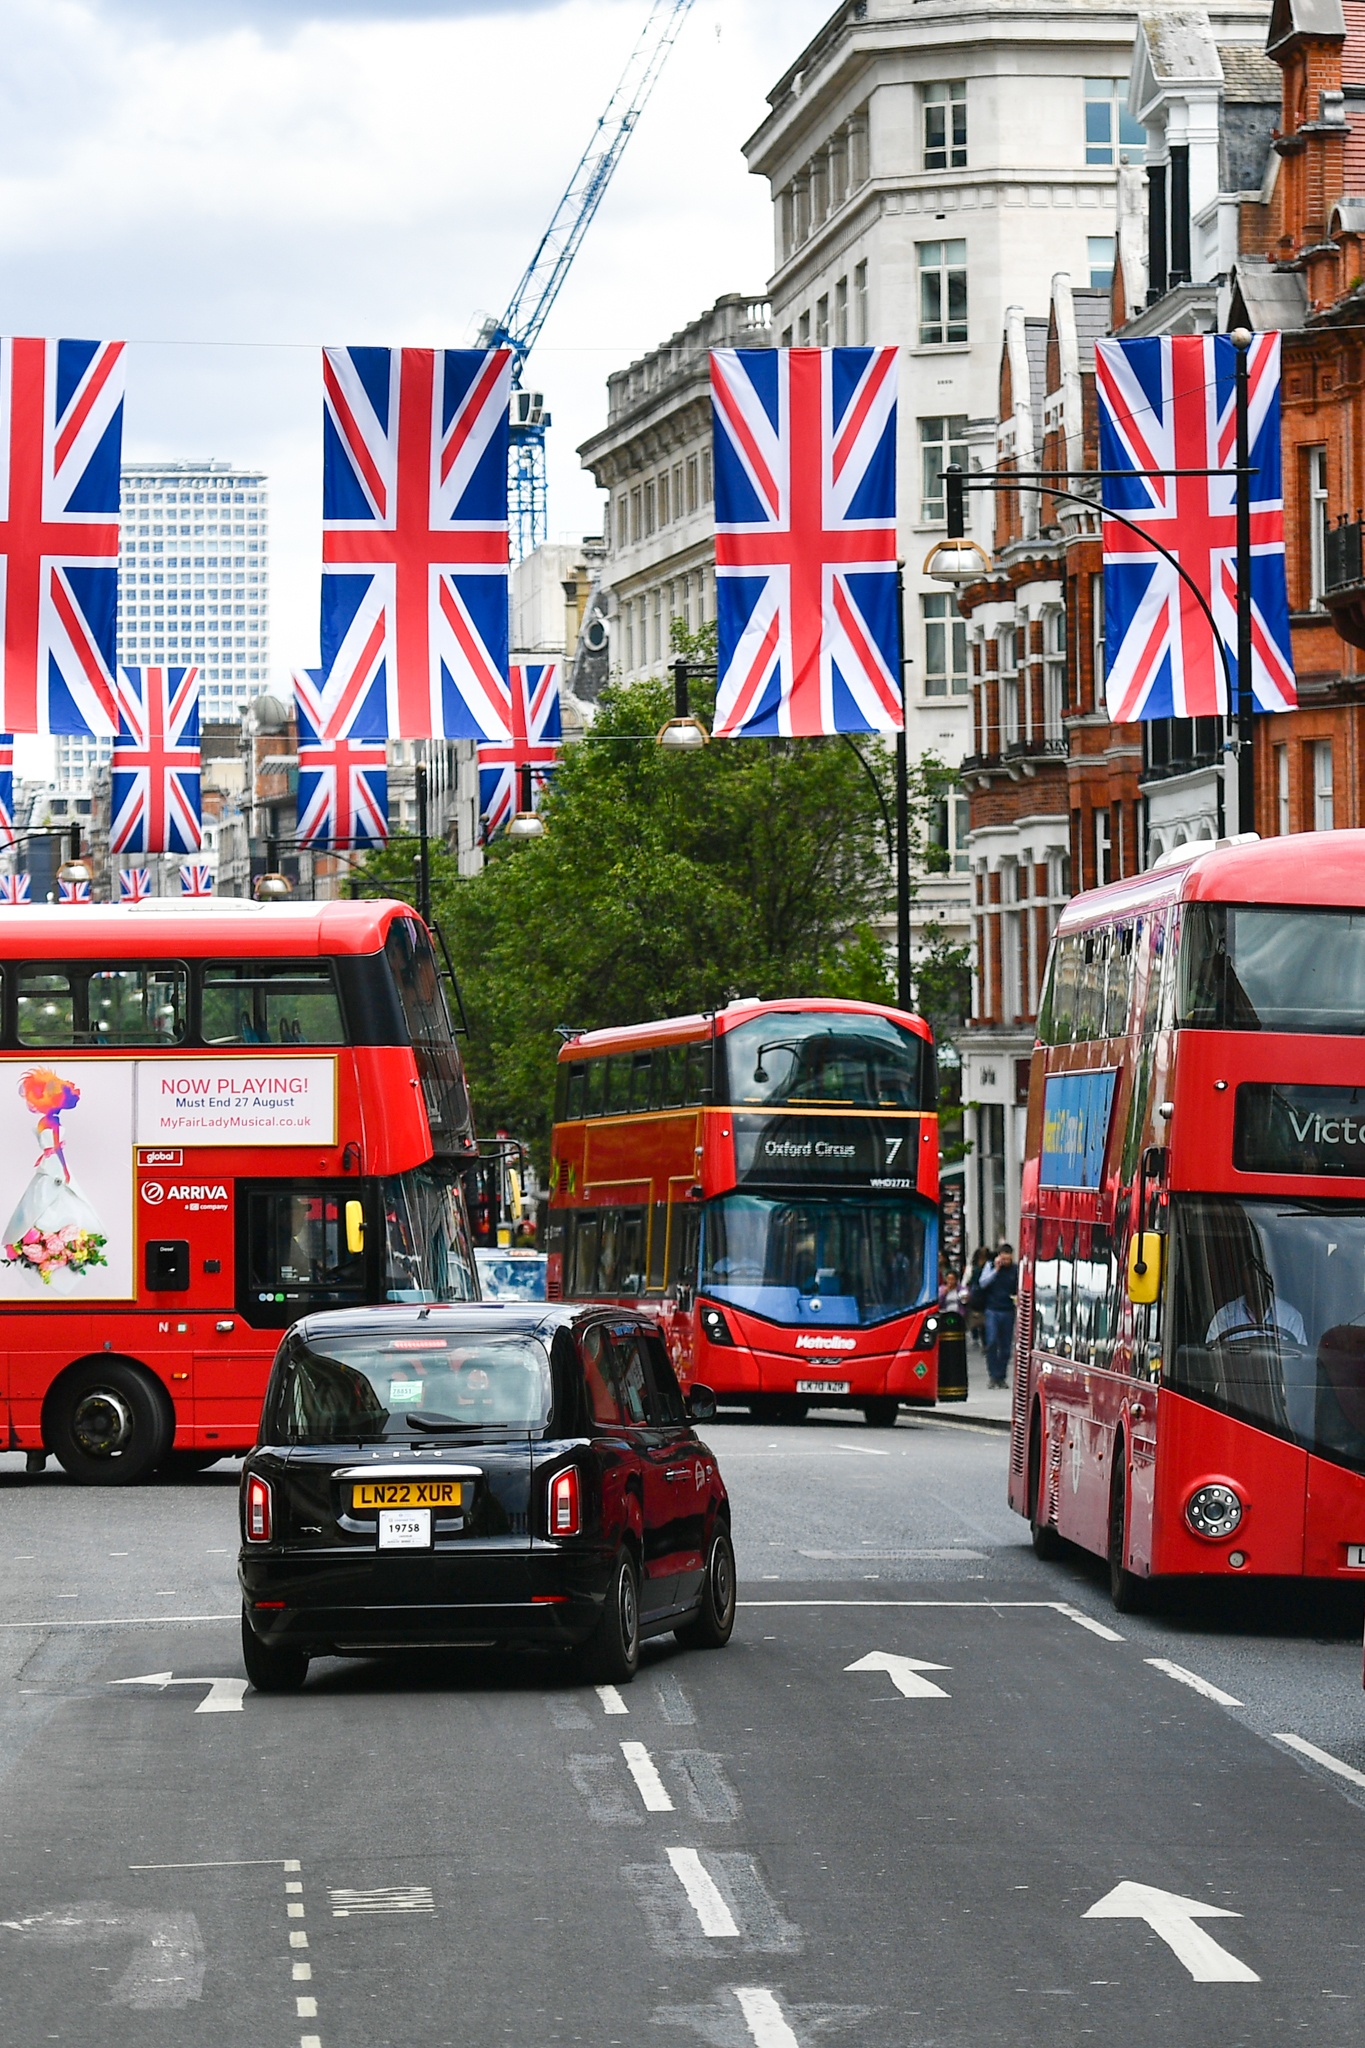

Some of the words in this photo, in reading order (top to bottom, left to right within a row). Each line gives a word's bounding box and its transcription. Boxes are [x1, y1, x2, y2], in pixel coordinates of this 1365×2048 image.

[161, 1078, 211, 1094] NOW
[217, 1077, 308, 1094] PLAYING!
[175, 1097, 205, 1108] Must
[209, 1097, 231, 1108] End
[234, 1097, 249, 1107] 27
[252, 1097, 295, 1109] August
[160, 1116, 311, 1129] MyFairLadyMusical.co.uk
[146, 1151, 174, 1164] global
[764, 1140, 812, 1157] Oxford
[814, 1140, 856, 1157] Circus
[884, 1137, 903, 1165] 7
[166, 1185, 228, 1200] ARRIVA
[795, 1334, 856, 1350] Metroline
[372, 1450, 443, 1458] LEVC
[361, 1485, 411, 1503] LN22
[416, 1484, 453, 1502] XUR
[389, 1523, 420, 1533] 19758
